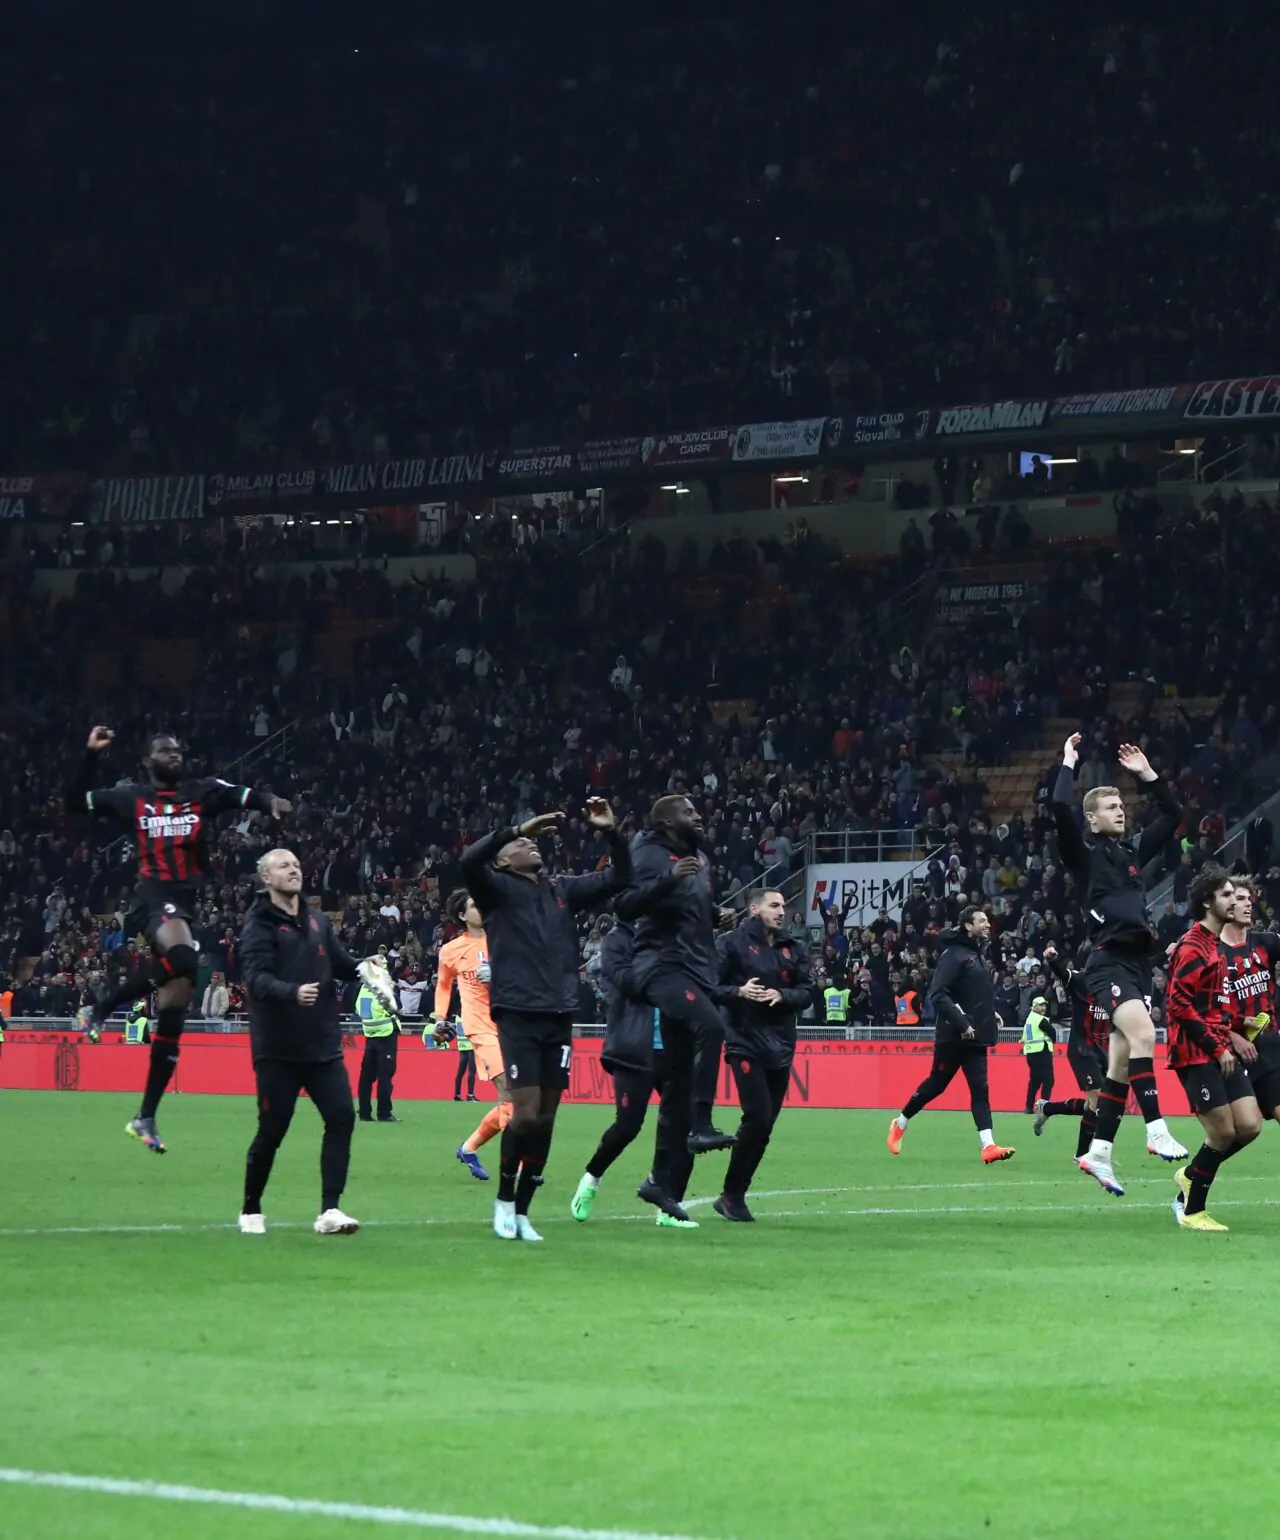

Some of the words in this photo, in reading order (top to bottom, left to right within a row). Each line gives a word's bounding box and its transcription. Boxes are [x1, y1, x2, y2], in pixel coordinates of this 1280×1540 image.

[856, 416, 876, 428] Fan
[325, 464, 377, 493] MILAN
[381, 459, 425, 489] CLUB
[427, 453, 484, 486] LATINA
[498, 454, 571, 474] SUPERSTAR
[227, 474, 273, 491] MILAN
[276, 470, 315, 488] CLUB
[1237, 987, 1251, 1000] FLY
